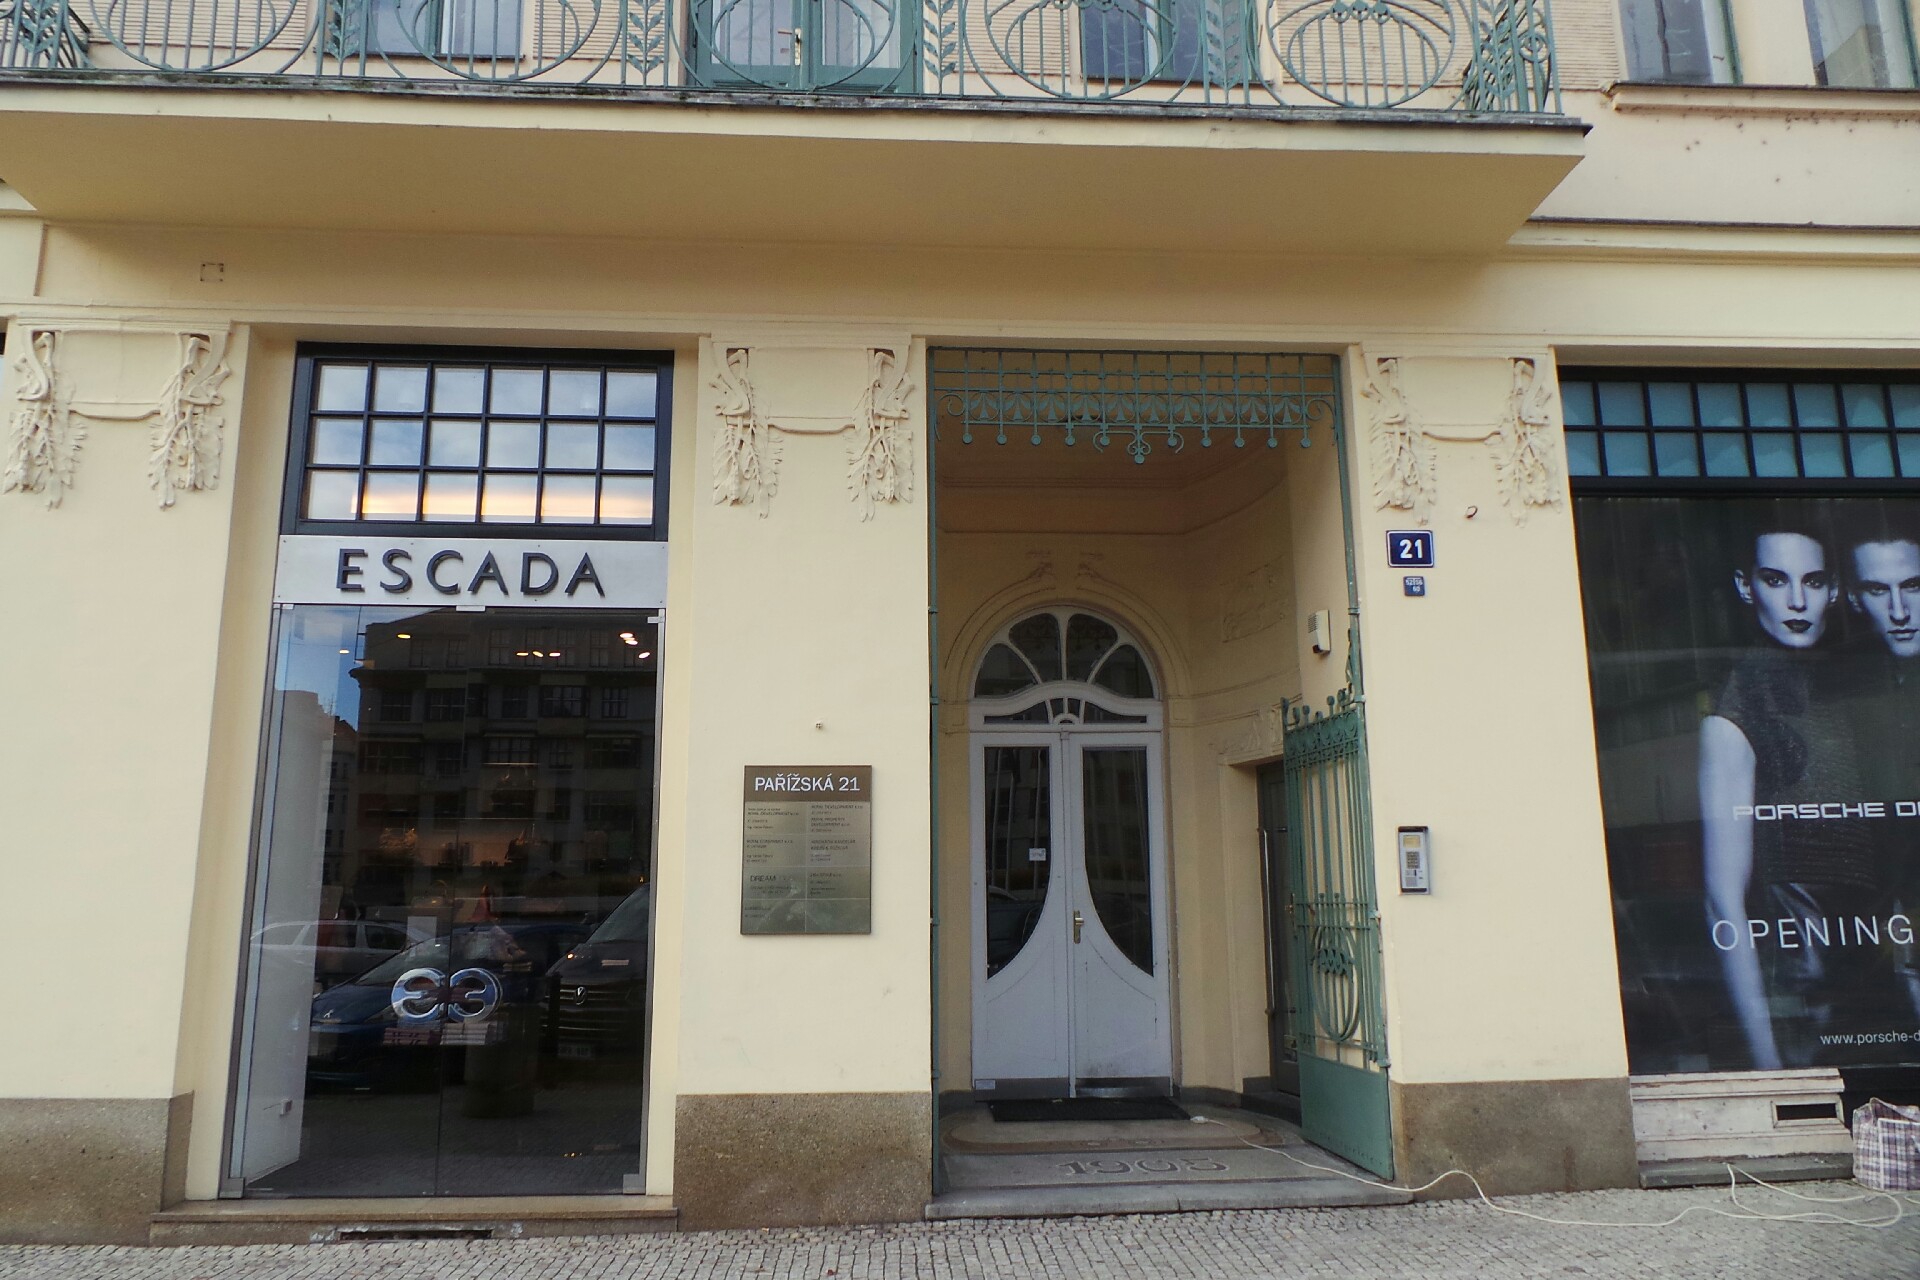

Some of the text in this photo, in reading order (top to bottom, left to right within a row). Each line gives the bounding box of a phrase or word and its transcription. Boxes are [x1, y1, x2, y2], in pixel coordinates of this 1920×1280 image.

[1399, 539, 1423, 559] 21
[336, 548, 605, 597] ESCADA
[754, 773, 861, 791] PAŘÍŽSKÁ 21
[1732, 801, 1920, 821] PORSCHE D
[1712, 914, 1914, 951] OPENING
